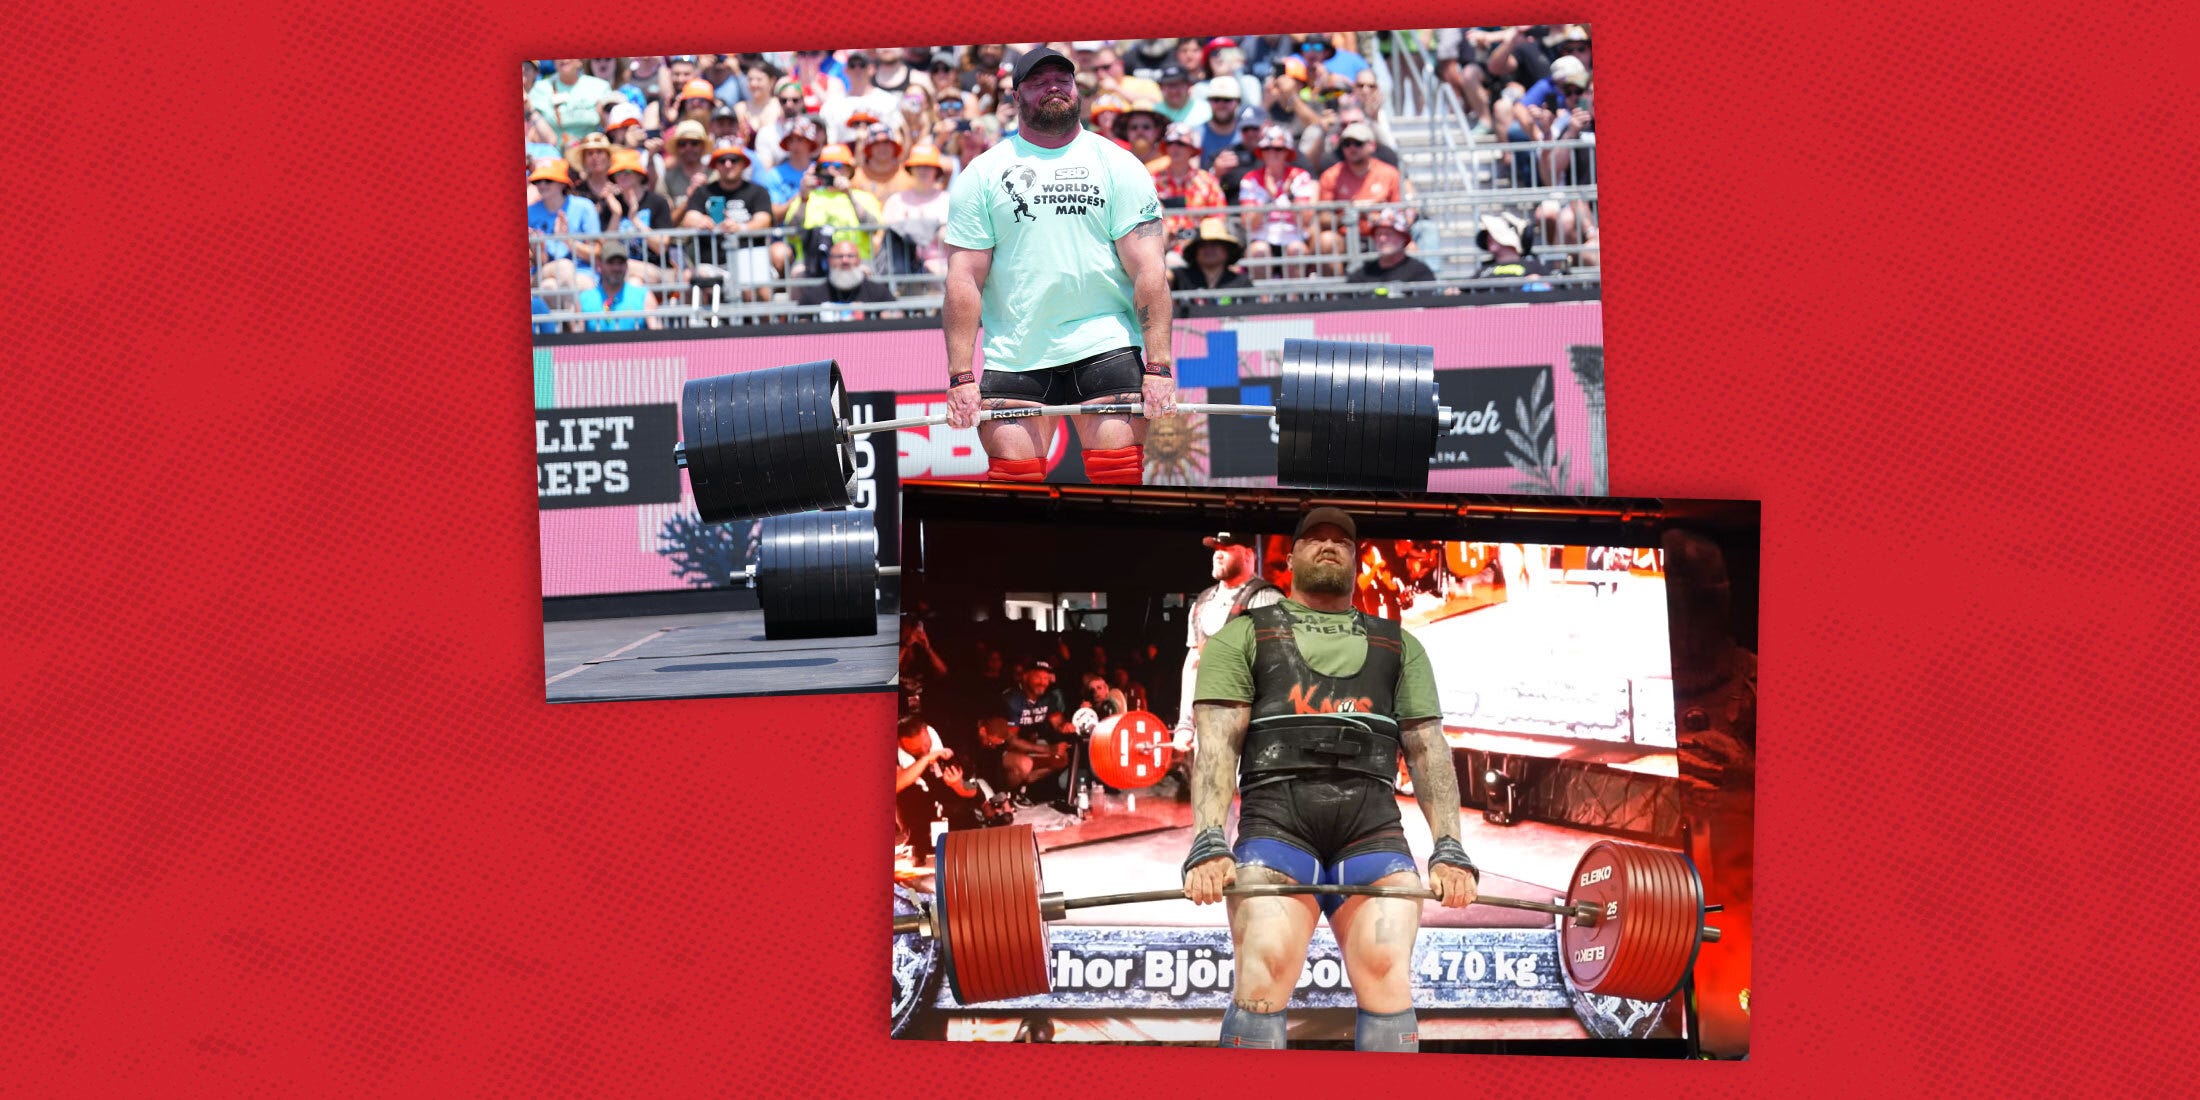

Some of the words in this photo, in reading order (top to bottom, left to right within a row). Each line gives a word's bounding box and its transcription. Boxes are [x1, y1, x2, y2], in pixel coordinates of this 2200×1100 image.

[1041, 183, 1100, 195] WORLD'S
[1034, 194, 1105, 208] STRONGEST
[1055, 205, 1087, 215] MAN
[993, 408, 1042, 419] ROGUE
[535, 416, 634, 453] LIFT
[1580, 865, 1612, 887] ELEIKO
[1606, 901, 1618, 916] 25
[1420, 950, 1486, 981] 470
[1495, 949, 1539, 987] kg
